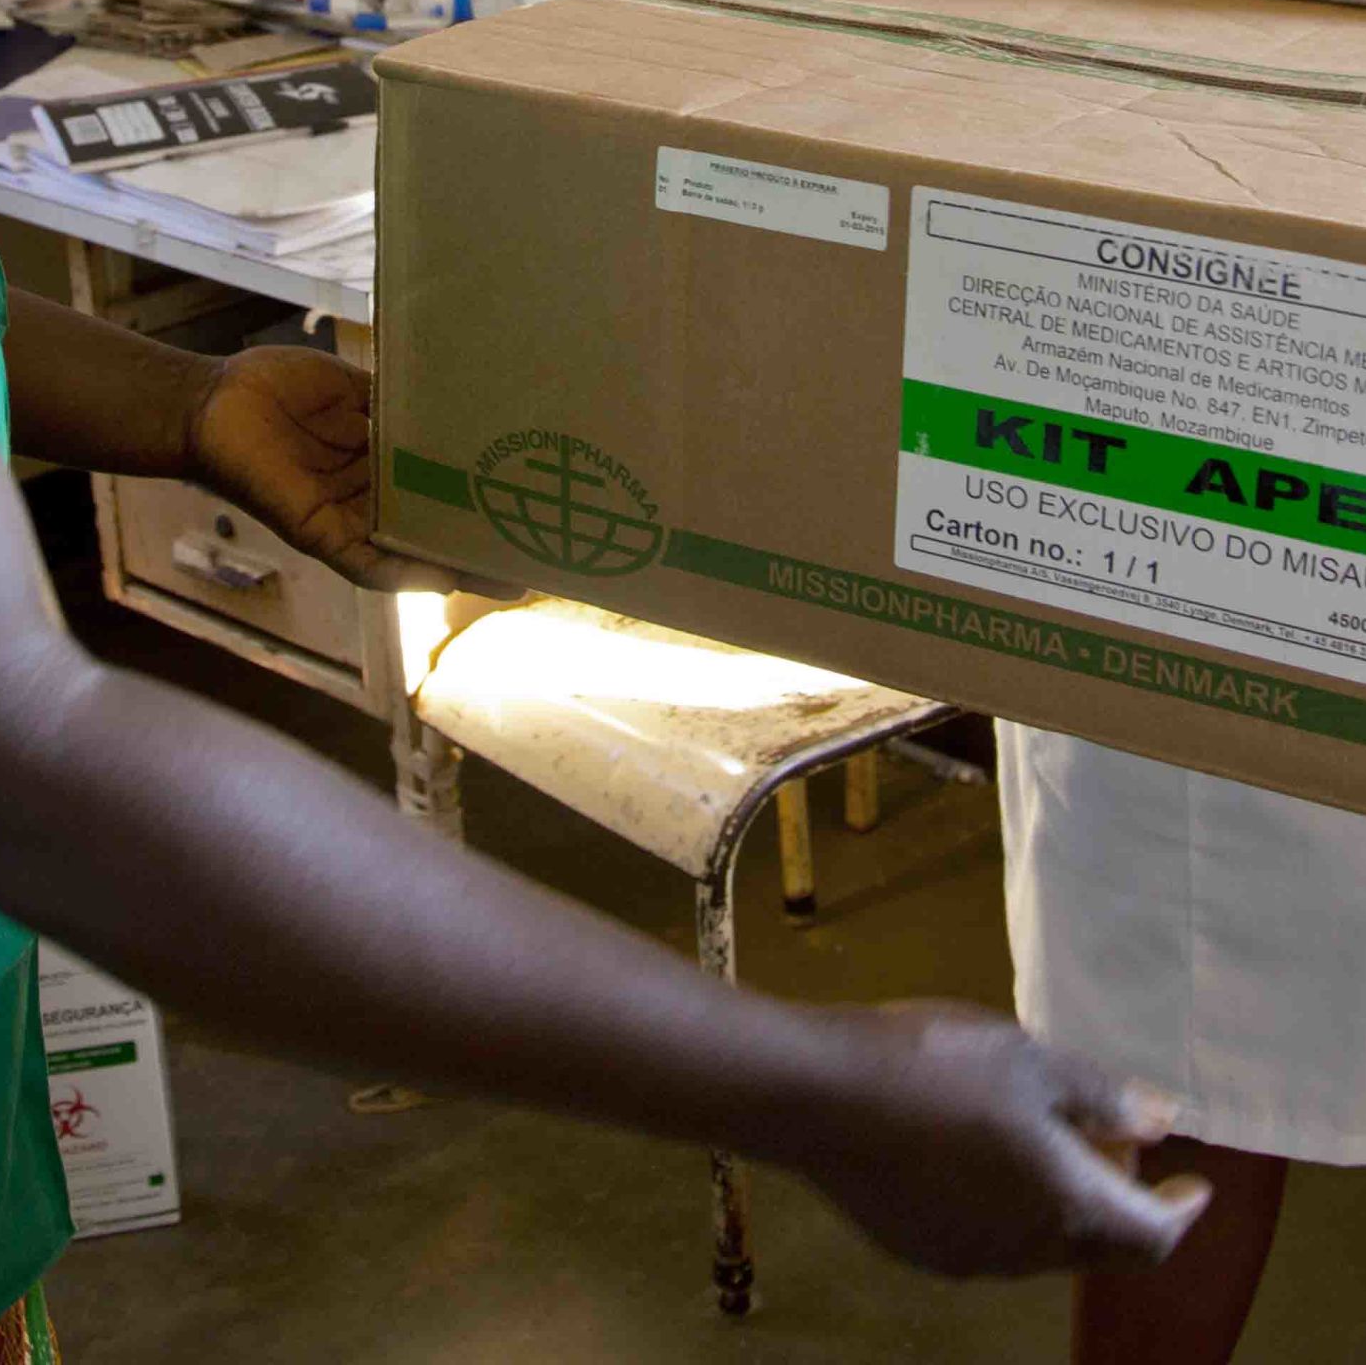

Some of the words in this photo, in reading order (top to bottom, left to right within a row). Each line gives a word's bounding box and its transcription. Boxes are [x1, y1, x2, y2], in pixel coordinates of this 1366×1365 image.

[1076, 269, 1192, 310] MINISTÉRIO
[1196, 294, 1223, 316] DA
[1229, 297, 1300, 331] SAÚDE
[1095, 236, 1303, 301] CONSIGNEE
[947, 295, 1035, 329] CENTRAL
[1040, 313, 1067, 335] DE
[1071, 320, 1232, 368] MEDICAMENTOS
[1237, 353, 1250, 372] E
[1254, 356, 1348, 392] ARTIGOS
[961, 271, 1061, 313] DIRECÇÃO
[1066, 295, 1165, 330] NACIONAL
[1171, 315, 1199, 337] DE
[1204, 318, 1338, 364] ASSISTÊNCIA
[993, 352, 1021, 374] Av.
[1026, 359, 1050, 380] De
[1055, 365, 1166, 407] Moçambique
[1020, 334, 1103, 366] Armazém
[1108, 352, 1185, 383] Nacional
[1189, 368, 1212, 388] de
[1216, 374, 1351, 418] Medicamentos
[974, 407, 1128, 479] KIT
[1160, 412, 1275, 454] Mozambique
[476, 428, 559, 476] MISSION
[570, 437, 660, 521] PHARMA
[926, 507, 1019, 552] Carton
[1029, 536, 1083, 567] no.:
[964, 474, 1029, 512] USO
[1038, 490, 1215, 555] EXCLUSIVO
[1224, 533, 1273, 568] DO
[767, 560, 1071, 661] MISSIONPHARMA
[1101, 643, 1300, 720] DENMARK
[42, 999, 146, 1028] SEGURANÇA
